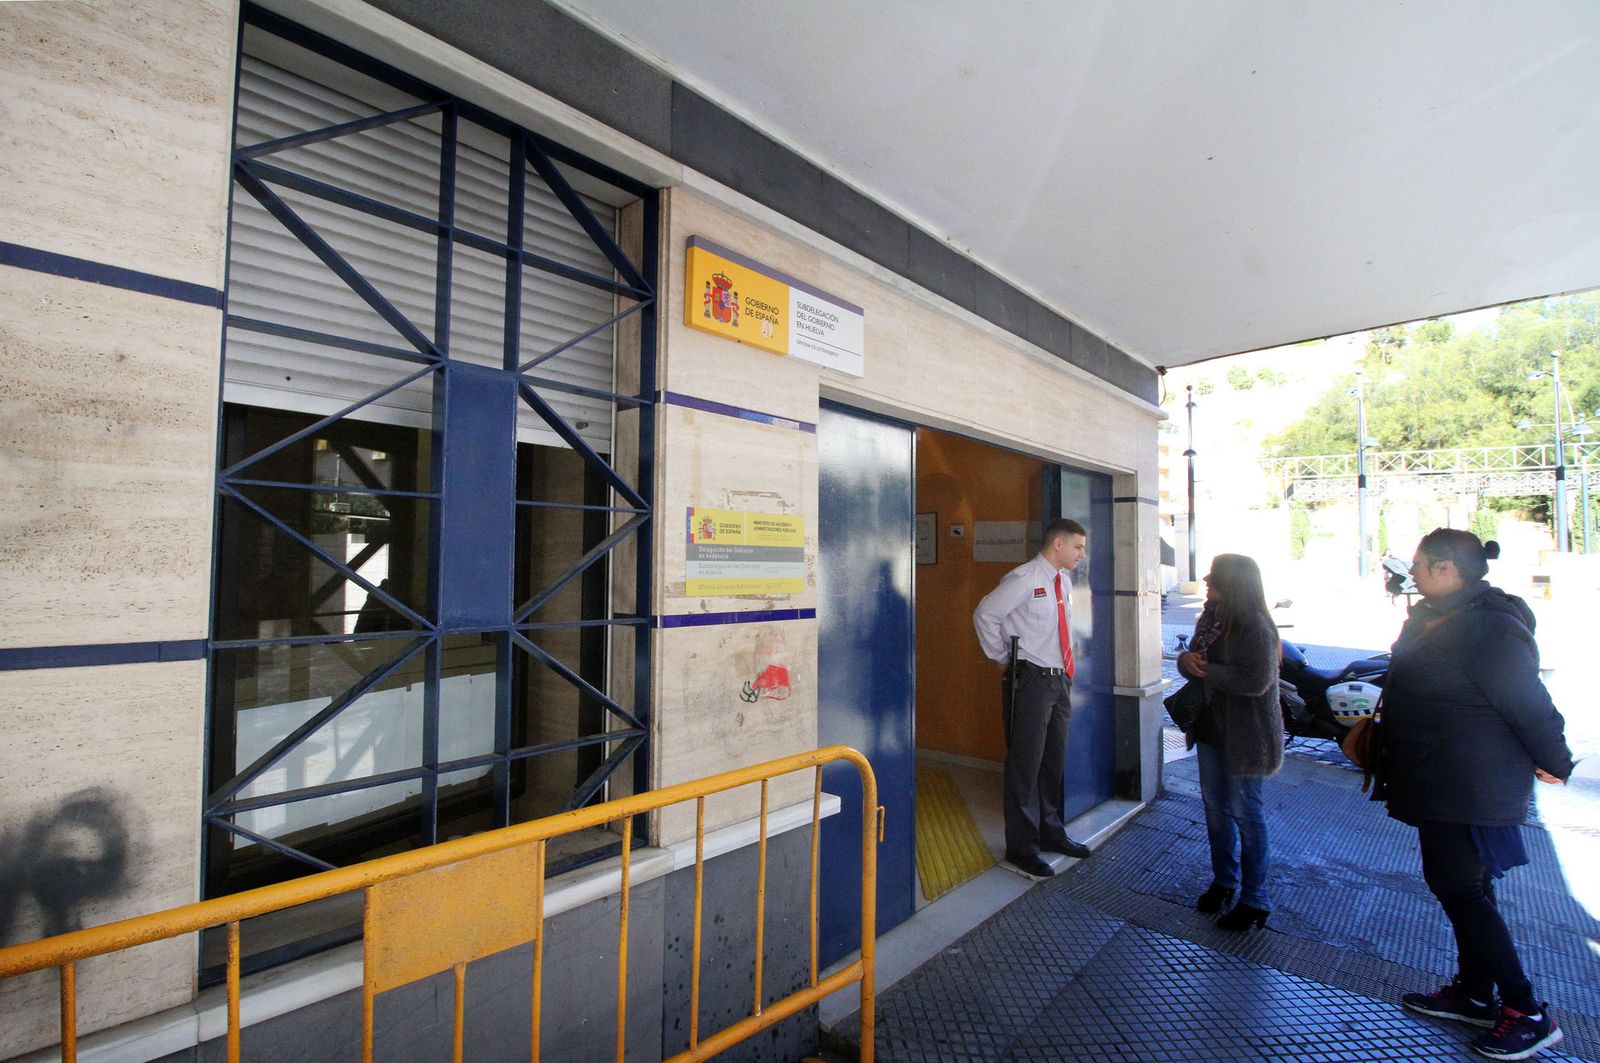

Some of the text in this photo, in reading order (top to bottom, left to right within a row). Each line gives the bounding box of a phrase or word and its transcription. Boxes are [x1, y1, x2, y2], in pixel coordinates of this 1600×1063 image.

[745, 297, 779, 315] GOBIERNO
[796, 301, 839, 323] SUBDELEGACIÓN
[745, 307, 779, 325] DE ESPAÑA
[796, 311, 835, 331] DEL GOBIERNO
[796, 321, 825, 337] EN HUELVA
